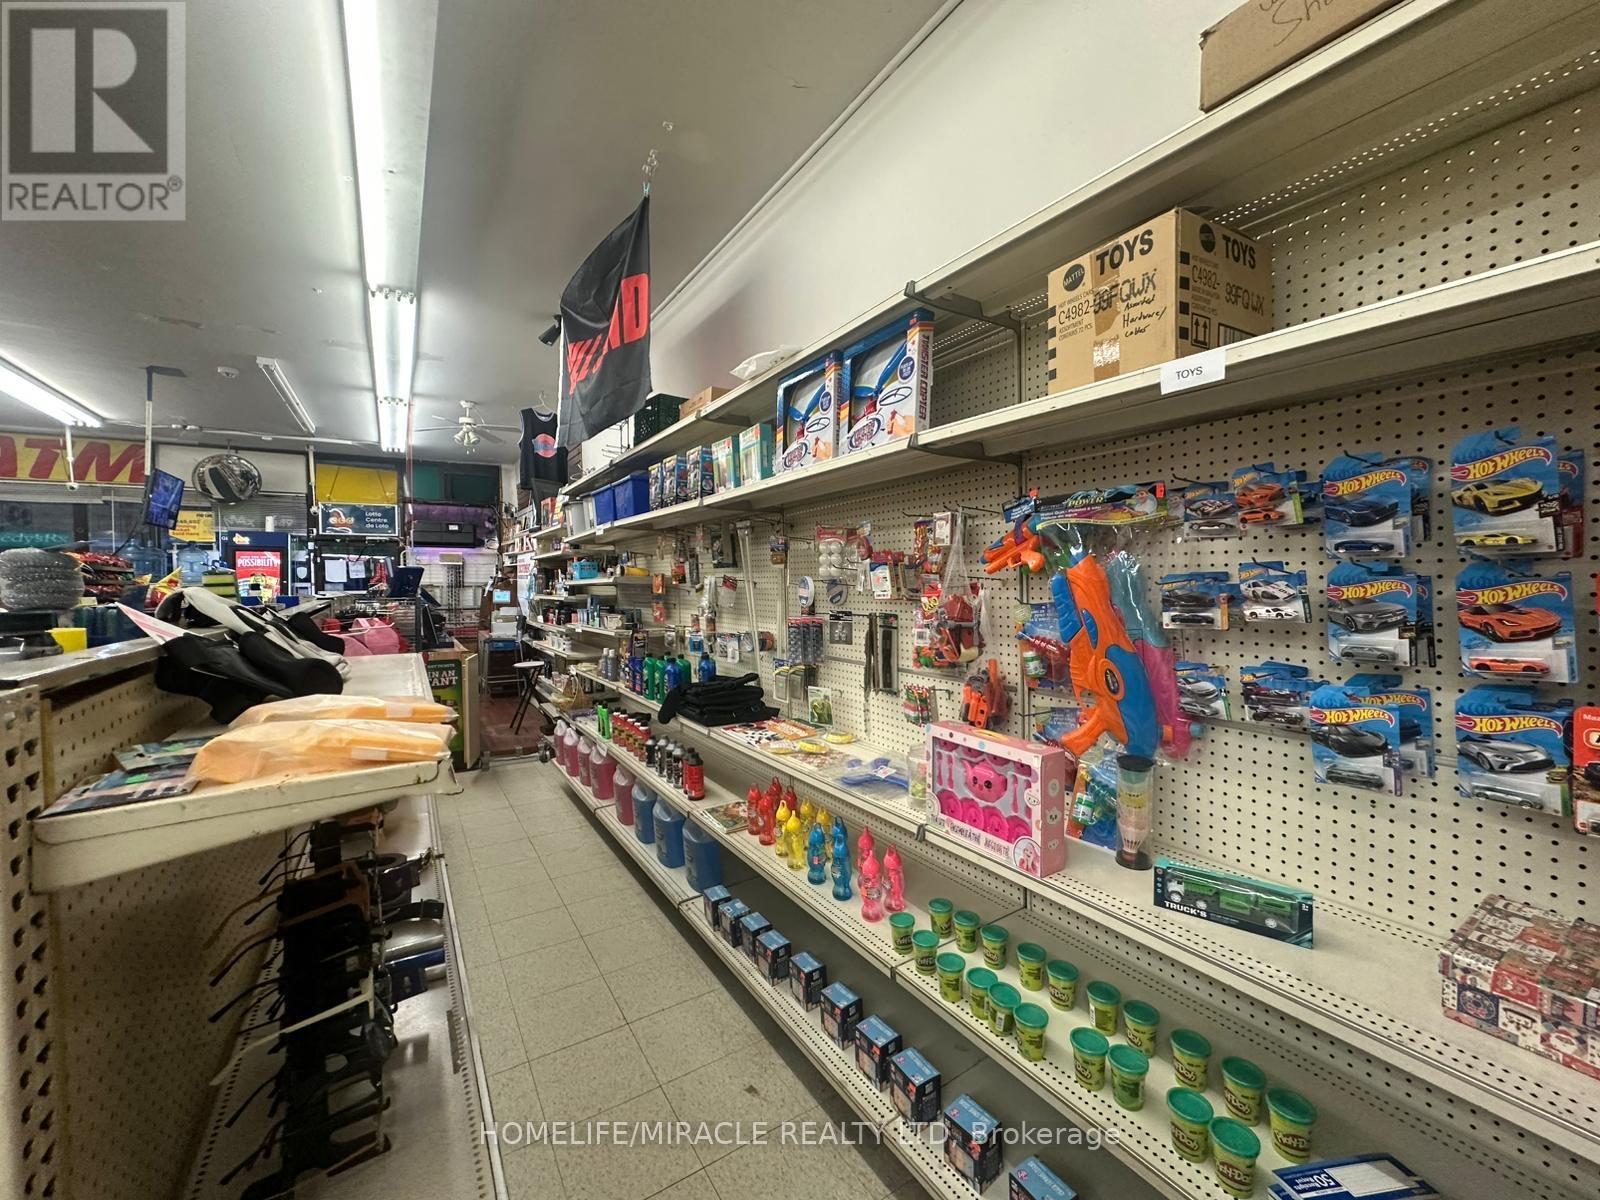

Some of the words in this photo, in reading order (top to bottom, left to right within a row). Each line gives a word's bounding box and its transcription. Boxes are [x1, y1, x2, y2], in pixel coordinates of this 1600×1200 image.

[1096, 229, 1154, 276] TOYS
[1222, 234, 1256, 269] TOYS
[1063, 269, 1085, 286] MATTEL
[1175, 366, 1203, 380] TOYS
[441, 669, 455, 678] AN
[1163, 900, 1208, 918] TRUCK'S
